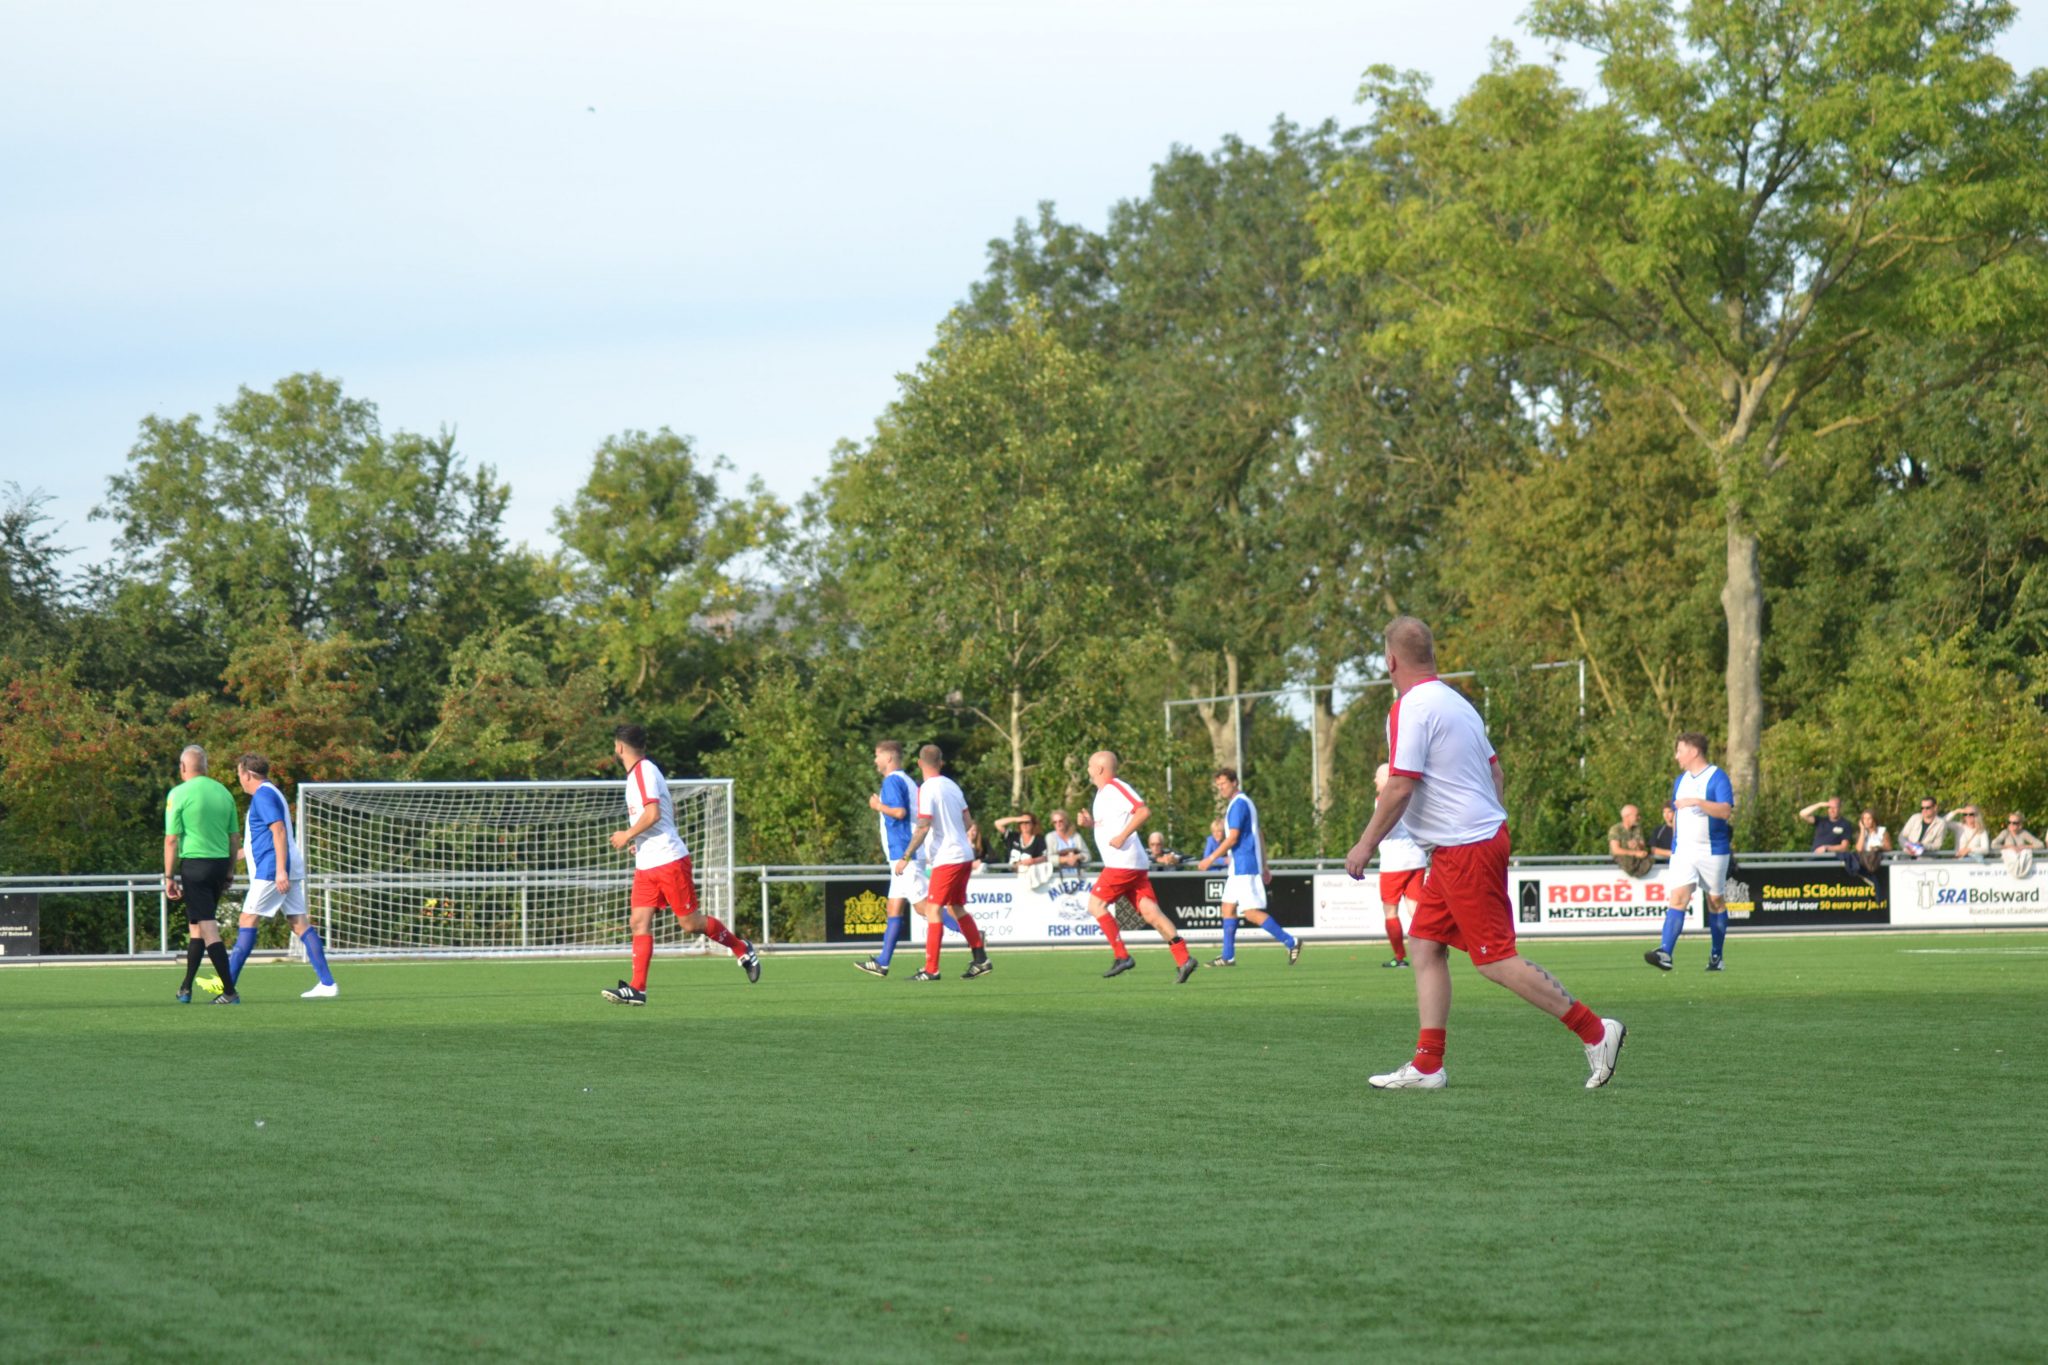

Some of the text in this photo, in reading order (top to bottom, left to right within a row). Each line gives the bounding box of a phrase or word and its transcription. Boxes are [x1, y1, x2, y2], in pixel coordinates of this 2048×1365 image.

[1762, 884, 1801, 899] Steun
[1936, 887, 2040, 904] SRA Bolsward
[1547, 906, 1694, 918] METSELWERKN
[1762, 901, 1786, 911] Word
[1786, 900, 1799, 911] lid
[1799, 902, 1819, 911] voor
[1819, 900, 1831, 911] 50
[1831, 901, 1852, 910] euro
[1852, 901, 1867, 912] per
[1003, 906, 1013, 919] 7
[855, 923, 888, 934] BOLSWAR
[1048, 924, 1070, 936] FISH
